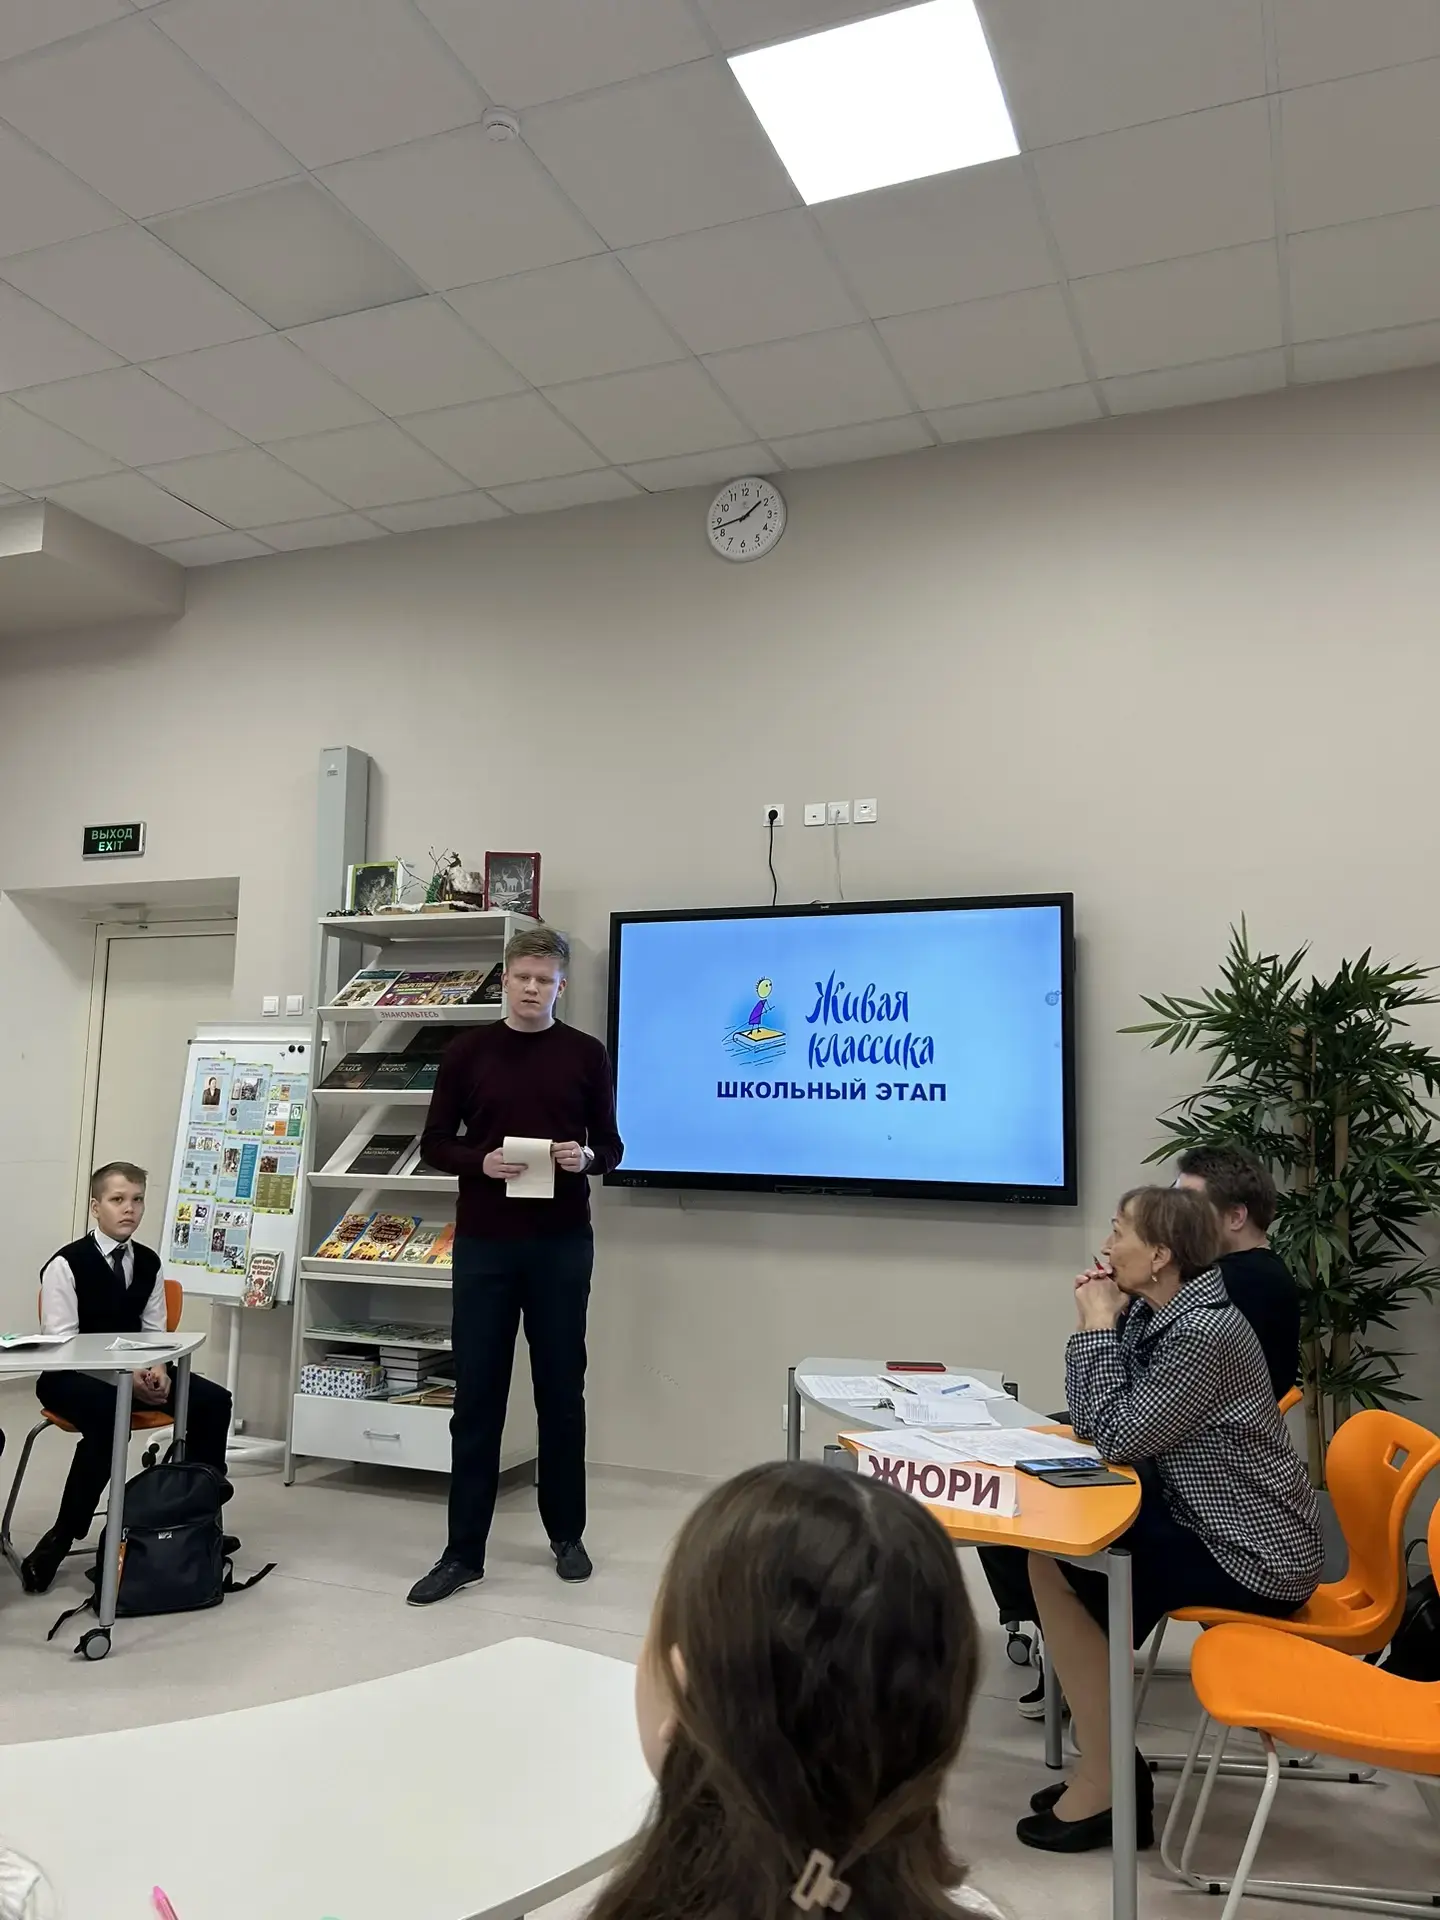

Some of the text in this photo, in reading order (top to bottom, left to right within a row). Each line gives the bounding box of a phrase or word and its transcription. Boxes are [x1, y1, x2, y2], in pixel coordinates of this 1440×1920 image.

[741, 488, 749, 496] 12
[730, 493, 737, 501] 11
[763, 498, 769, 507] 2
[721, 504, 729, 512] 10
[767, 510, 772, 518] 3
[716, 517, 722, 525] 9
[762, 523, 768, 531] 4
[720, 528, 725, 537] 8
[728, 537, 734, 546] 7
[755, 534, 760, 542] 5
[740, 540, 745, 548] 6
[91, 828, 133, 840] ВЫХОД
[98, 841, 124, 851] EXIT
[805, 969, 909, 1025] Живая
[808, 1032, 934, 1070] классика
[717, 1078, 946, 1101] ШКОЛЬНЫЙ ЭТАП
[869, 1455, 1000, 1509] ЖЮРИ
